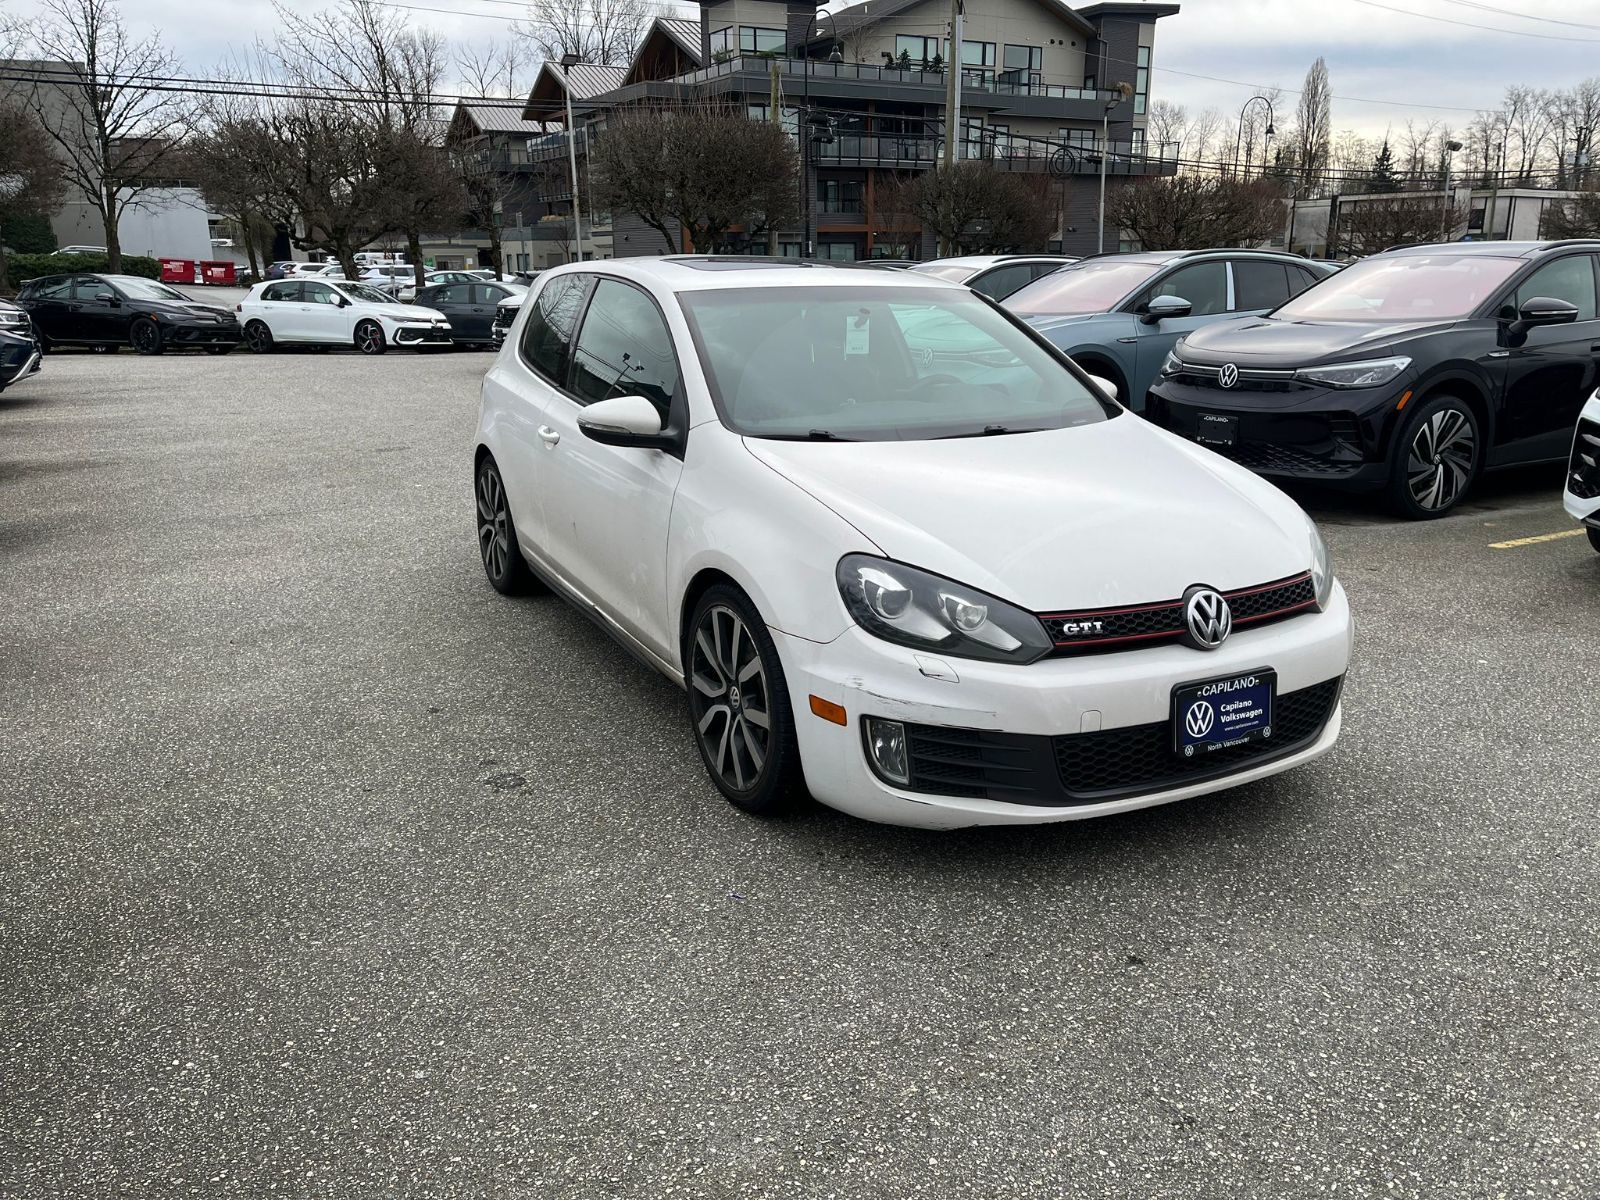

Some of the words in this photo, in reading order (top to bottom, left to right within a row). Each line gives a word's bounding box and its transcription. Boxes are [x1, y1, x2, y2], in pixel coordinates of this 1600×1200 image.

[1219, 363, 1238, 388] VW
[1205, 415, 1227, 423] CAPILANO
[1188, 590, 1232, 648] VW
[1063, 621, 1104, 636] GTI
[1202, 676, 1255, 697] CAPILANO
[1220, 700, 1252, 712] Capilano
[1186, 701, 1214, 737] VW
[1220, 708, 1263, 723] Volkswagen
[1207, 743, 1222, 752] North
[1223, 736, 1250, 748] Vancouver
